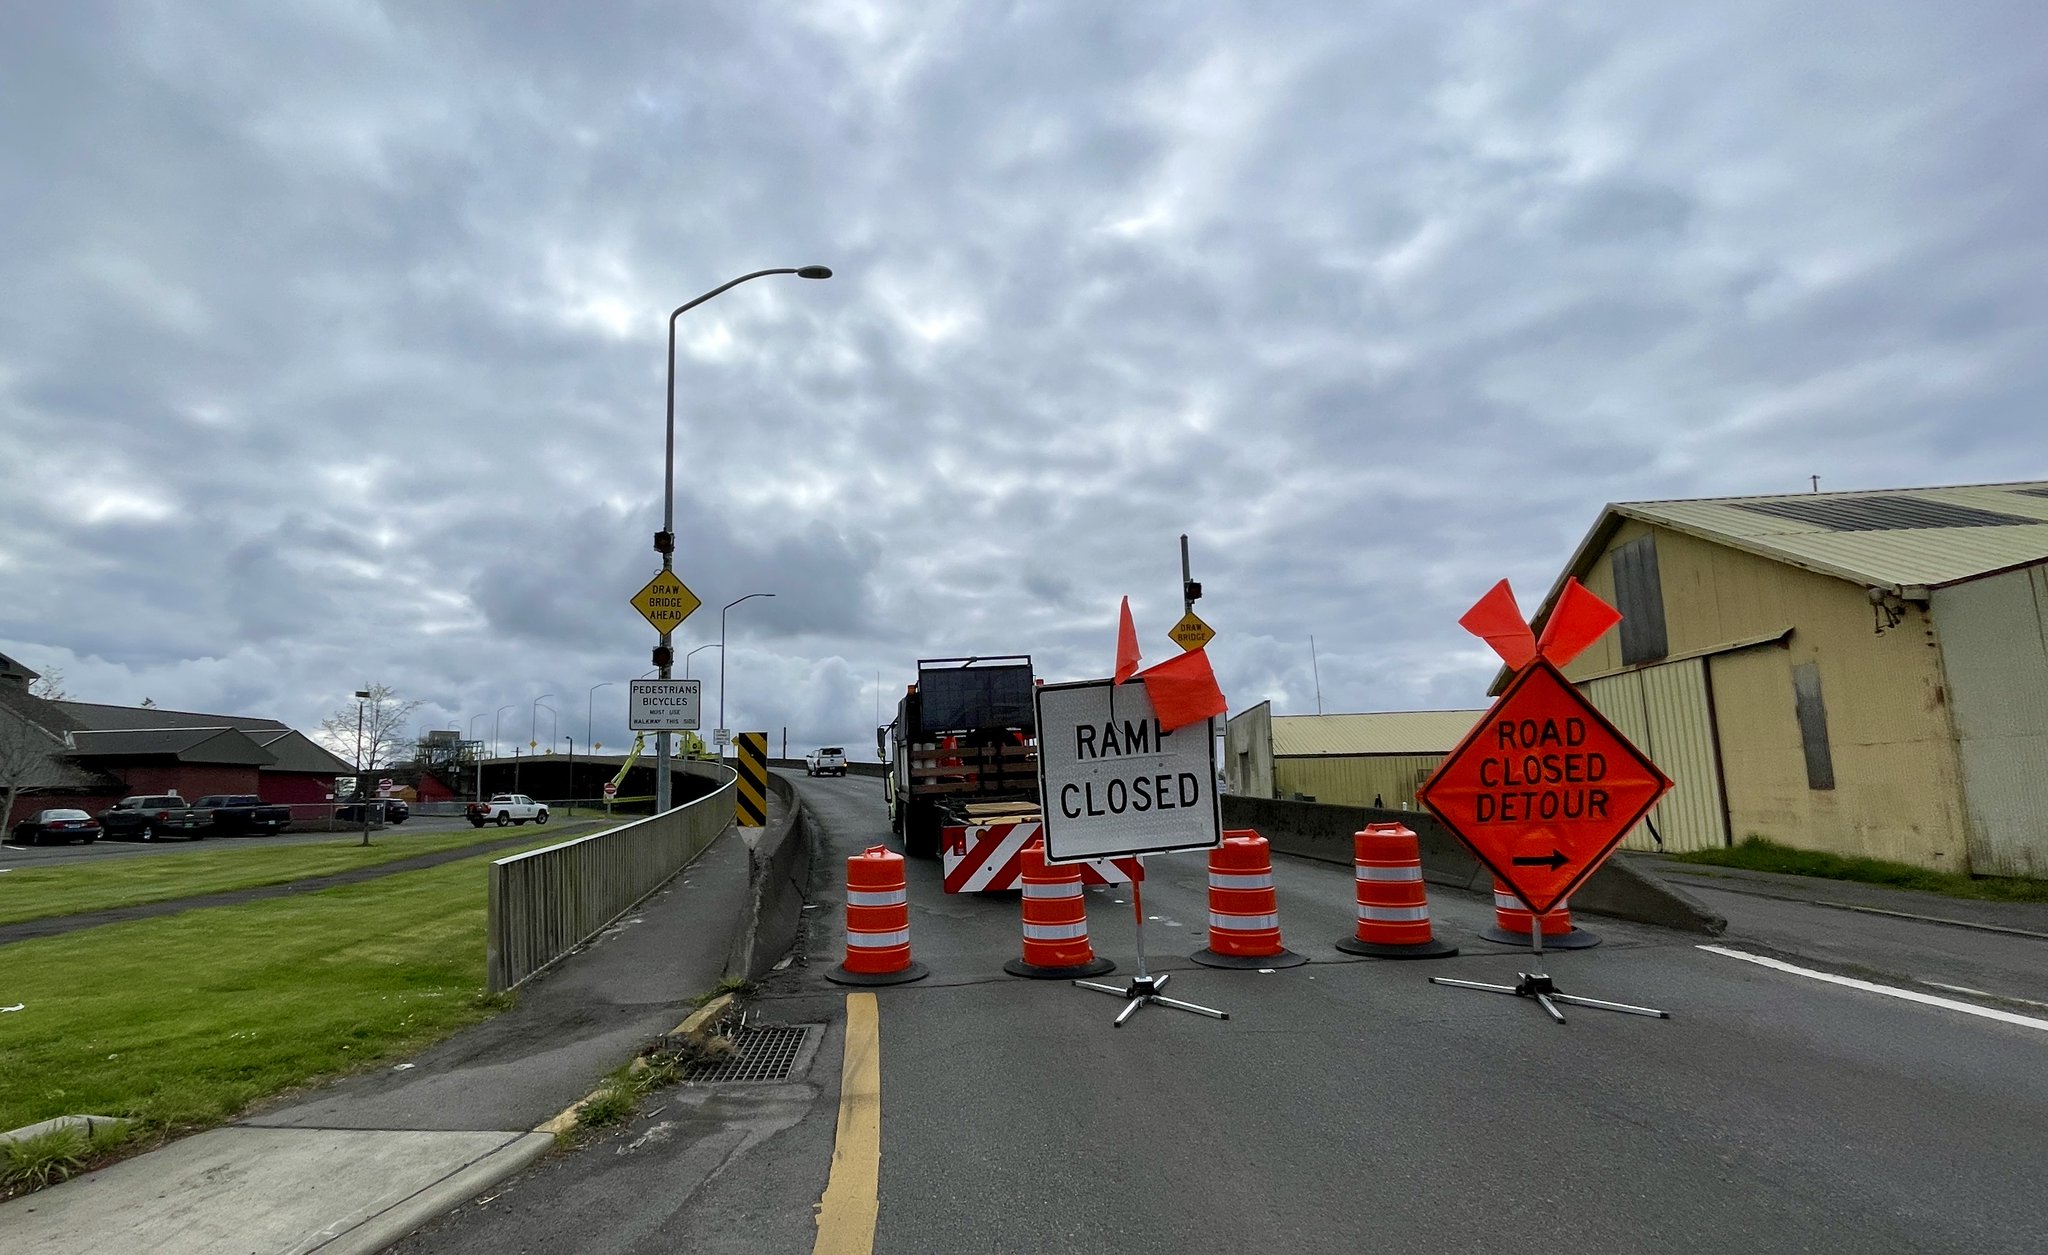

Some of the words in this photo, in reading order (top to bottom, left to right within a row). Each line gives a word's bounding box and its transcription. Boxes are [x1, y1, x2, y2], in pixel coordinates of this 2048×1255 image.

[652, 585, 680, 595] DRAW
[649, 597, 682, 608] BRIDGE
[649, 610, 682, 620] AHEAD
[1180, 623, 1202, 632] DRAW
[1177, 632, 1207, 642] BRIDGE
[632, 685, 698, 694] PEDESTRIANS
[642, 697, 688, 706] BICYCLES
[1498, 717, 1586, 750] ROAD
[1479, 752, 1607, 788] CLOSED
[1060, 772, 1199, 819] CLOSED
[1476, 788, 1610, 823] DETOUR
